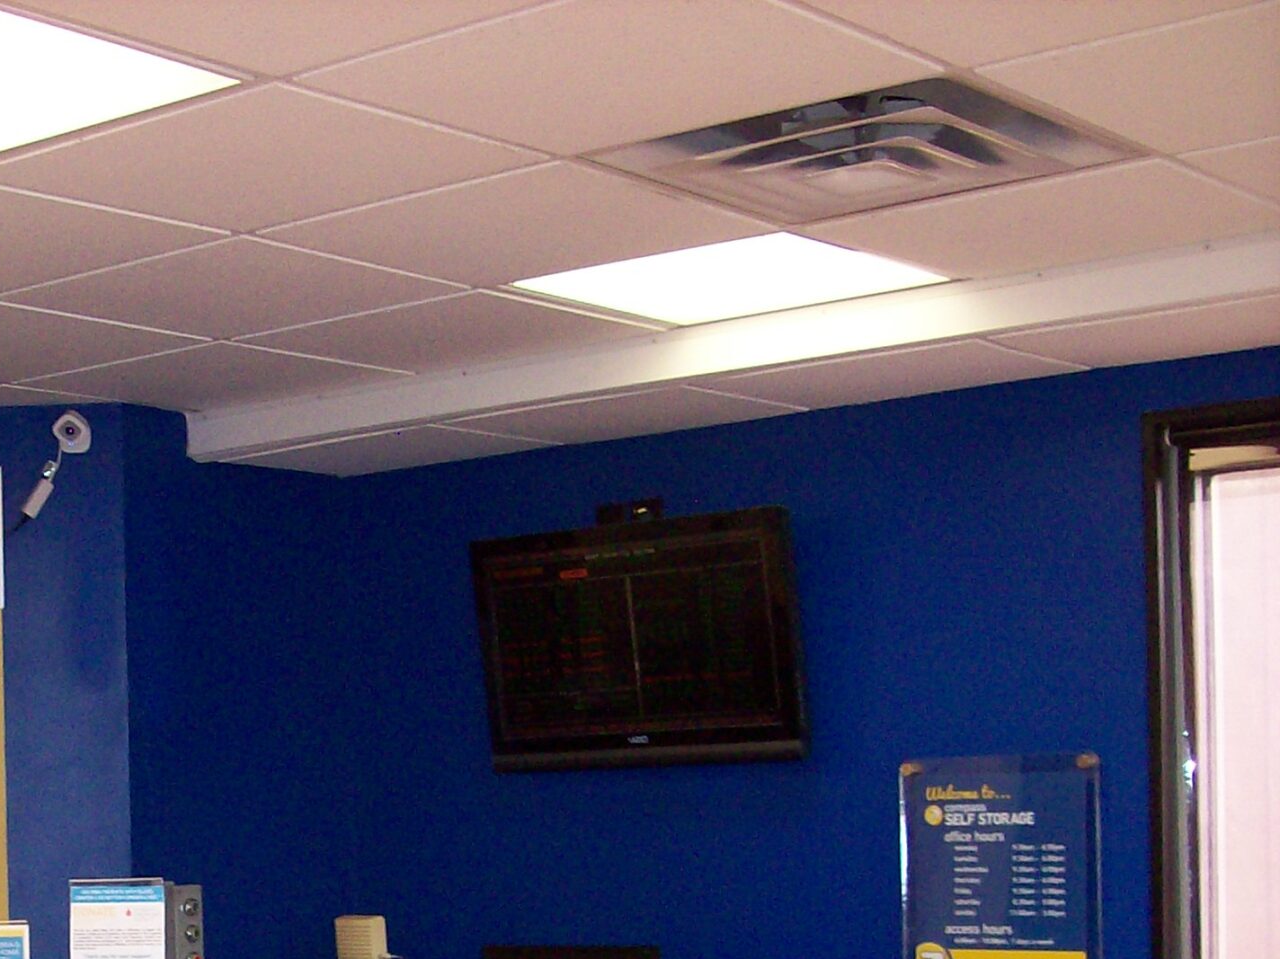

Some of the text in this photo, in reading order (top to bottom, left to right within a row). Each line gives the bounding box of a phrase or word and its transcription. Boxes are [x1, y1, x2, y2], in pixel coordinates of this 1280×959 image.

[944, 811, 1035, 826] SELF STORAGE
[944, 830, 1005, 842] office hours
[982, 923, 1013, 936] hours
